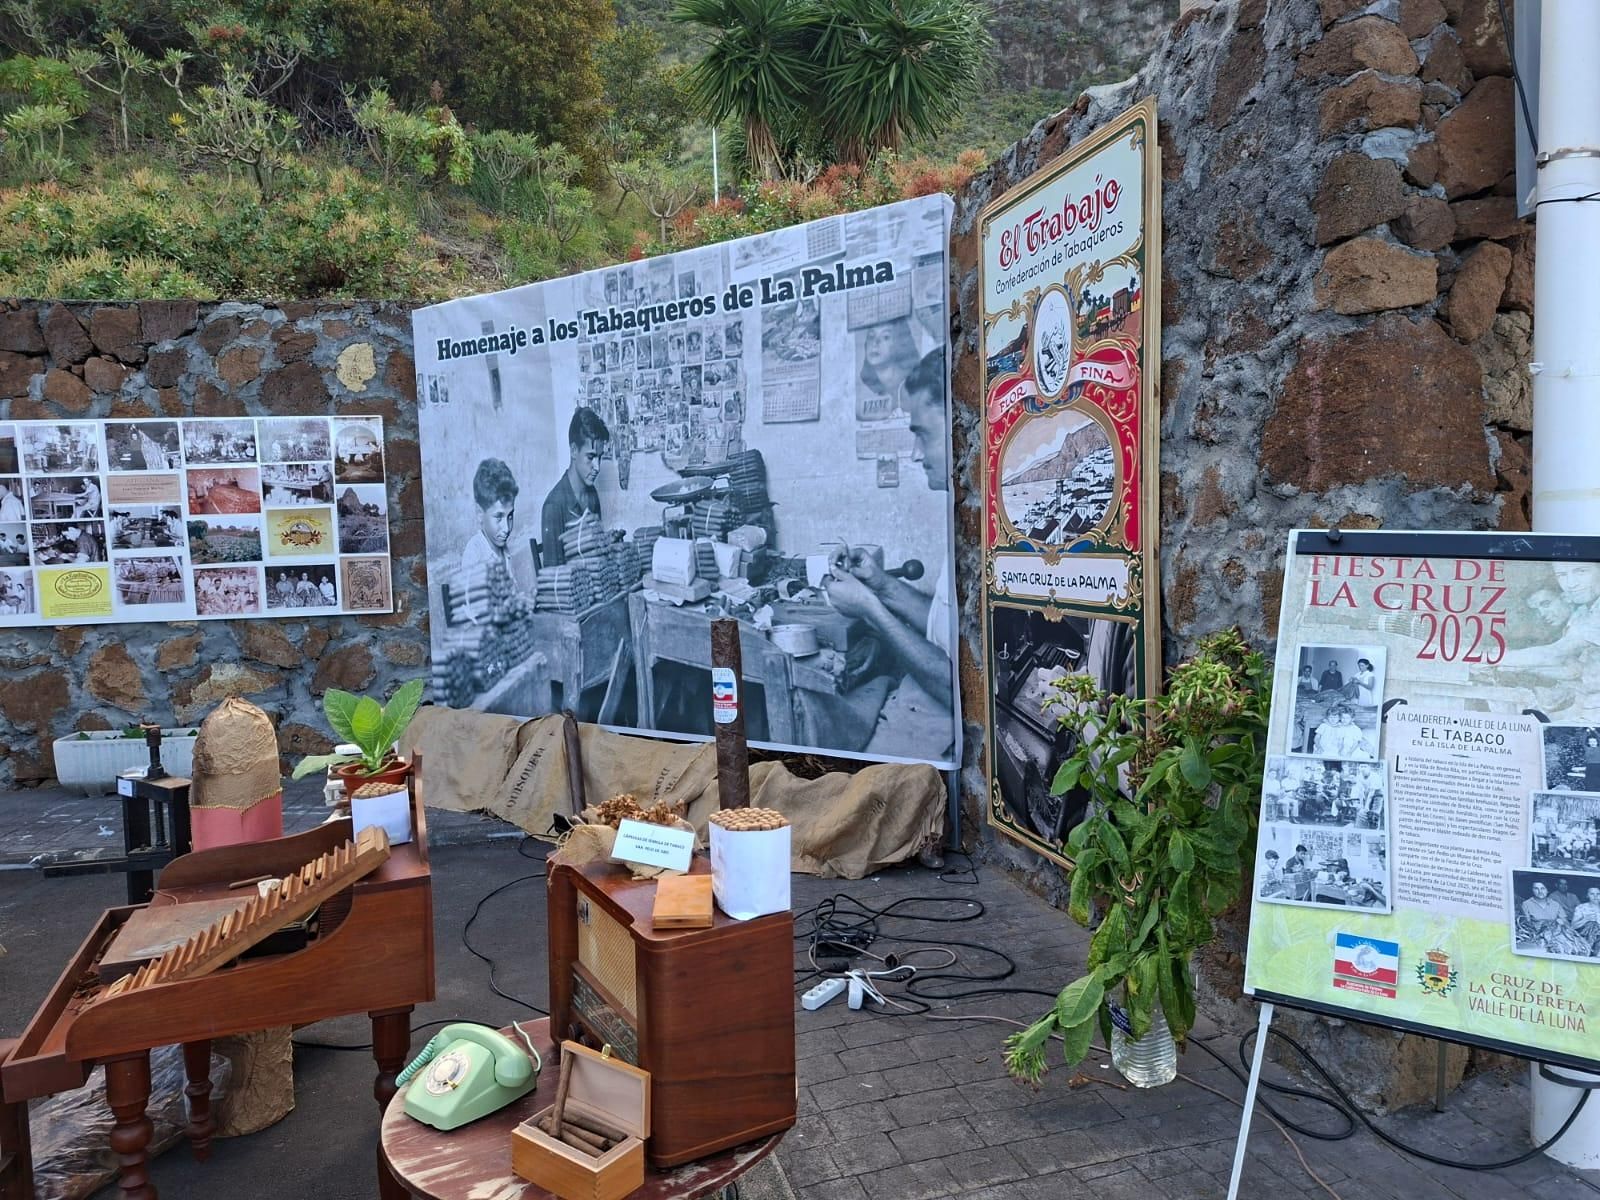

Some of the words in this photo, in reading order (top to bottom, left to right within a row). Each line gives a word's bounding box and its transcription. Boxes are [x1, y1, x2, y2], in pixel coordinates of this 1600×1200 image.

[999, 224, 1021, 271] El
[1023, 174, 1123, 257] Trabajo
[995, 257, 1050, 295] Confederación
[1051, 250, 1063, 266] de
[1064, 221, 1123, 260] Tabaqueros
[437, 328, 527, 361] Homenaje
[530, 325, 545, 345] a
[549, 317, 579, 342] los
[584, 297, 716, 335] Tabaqueros
[723, 284, 753, 311] de
[760, 277, 795, 305] La
[802, 261, 894, 297] Palma
[1080, 367, 1124, 384] FINA
[1000, 386, 1027, 413] FLOR
[1001, 571, 1028, 586] SANTA
[1029, 572, 1054, 586] CRUZ
[1054, 576, 1066, 588] DE
[1067, 577, 1077, 588] LA
[1079, 575, 1118, 591] PALMA
[1312, 556, 1437, 580] FIESTA
[1455, 560, 1505, 582] DE
[1309, 580, 1358, 608] LA
[1373, 583, 1507, 615] CRUZ
[1416, 613, 1507, 665] 2025
[1397, 712, 1406, 722] LA
[1407, 713, 1451, 725] CALDERETA
[1459, 718, 1482, 729] VALLE
[1484, 720, 1495, 730] DE
[1497, 721, 1507, 731] LA
[1509, 722, 1532, 733] LUNA
[1412, 739, 1422, 747] EN
[1425, 740, 1435, 748] LA
[1437, 741, 1456, 750] ISLA
[1458, 743, 1467, 751] DE
[1471, 745, 1481, 753] LA
[1484, 746, 1512, 756] PALMA
[1421, 727, 1439, 740] EL
[1444, 729, 1505, 746] TABACO
[1490, 972, 1536, 992] CRUZ
[1541, 982, 1563, 995] DE
[1469, 981, 1487, 995] LA
[1491, 986, 1586, 1015] CALDERETA
[1468, 995, 1505, 1017] VALLE
[1510, 1004, 1527, 1021] DE
[1530, 1008, 1545, 1024] LA
[1549, 1013, 1586, 1033] LUNA
